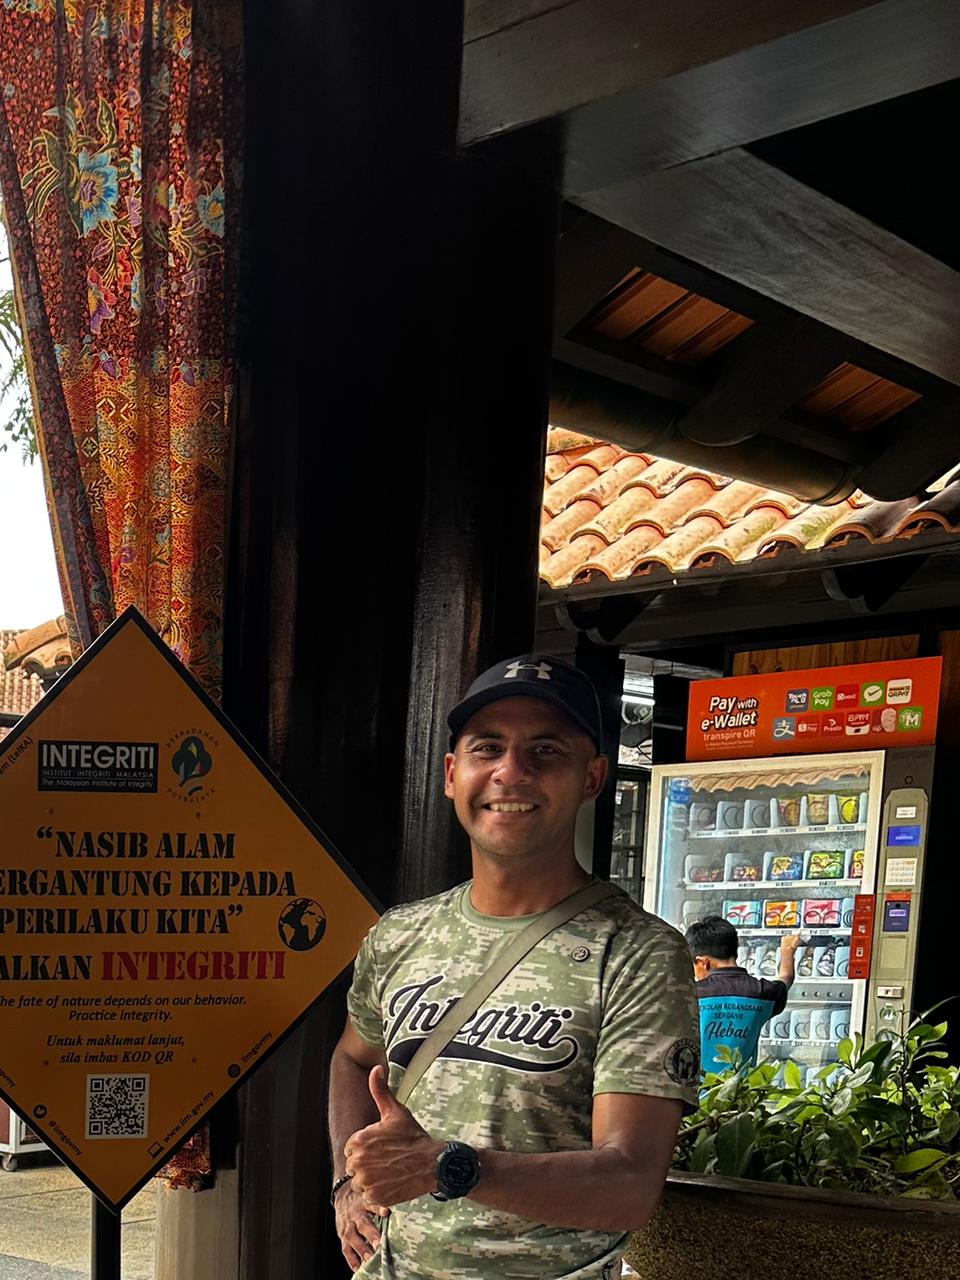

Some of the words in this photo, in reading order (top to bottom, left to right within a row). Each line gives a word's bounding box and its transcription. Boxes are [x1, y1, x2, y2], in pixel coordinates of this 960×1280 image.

[709, 696, 736, 713] Pay
[737, 698, 757, 709] with
[701, 710, 757, 731] e-Wallet
[703, 731, 741, 741] transpire
[42, 744, 154, 769] INTEGRITI
[42, 769, 72, 777] INSTITUT
[77, 769, 111, 778] INTEGRITI
[115, 770, 154, 778] MALAYSIA
[56, 779, 90, 788] Malaysian
[92, 779, 117, 787] Institute
[118, 780, 127, 788] of
[37, 826, 148, 858] “NASIB
[155, 832, 235, 859] ALAM
[179, 871, 296, 897] KEPADA
[156, 904, 243, 935] KITA”
[101, 951, 287, 981] INTEGRITI
[17, 994, 43, 1009] fate
[46, 994, 60, 1009] of
[62, 996, 101, 1007] nature
[104, 995, 152, 1008] depends
[155, 997, 169, 1006] on
[172, 997, 192, 1006] our
[194, 994, 246, 1006] behavior.
[68, 1009, 117, 1021] Practice
[120, 1009, 172, 1023] integrity.
[46, 1034, 83, 1047] Untuk
[86, 1034, 146, 1046] maklumat
[148, 1034, 185, 1048] lanjut,
[59, 1051, 81, 1064] sila
[83, 1051, 118, 1063] imbas
[121, 1051, 152, 1063] KOD
[155, 1050, 174, 1064] QR
